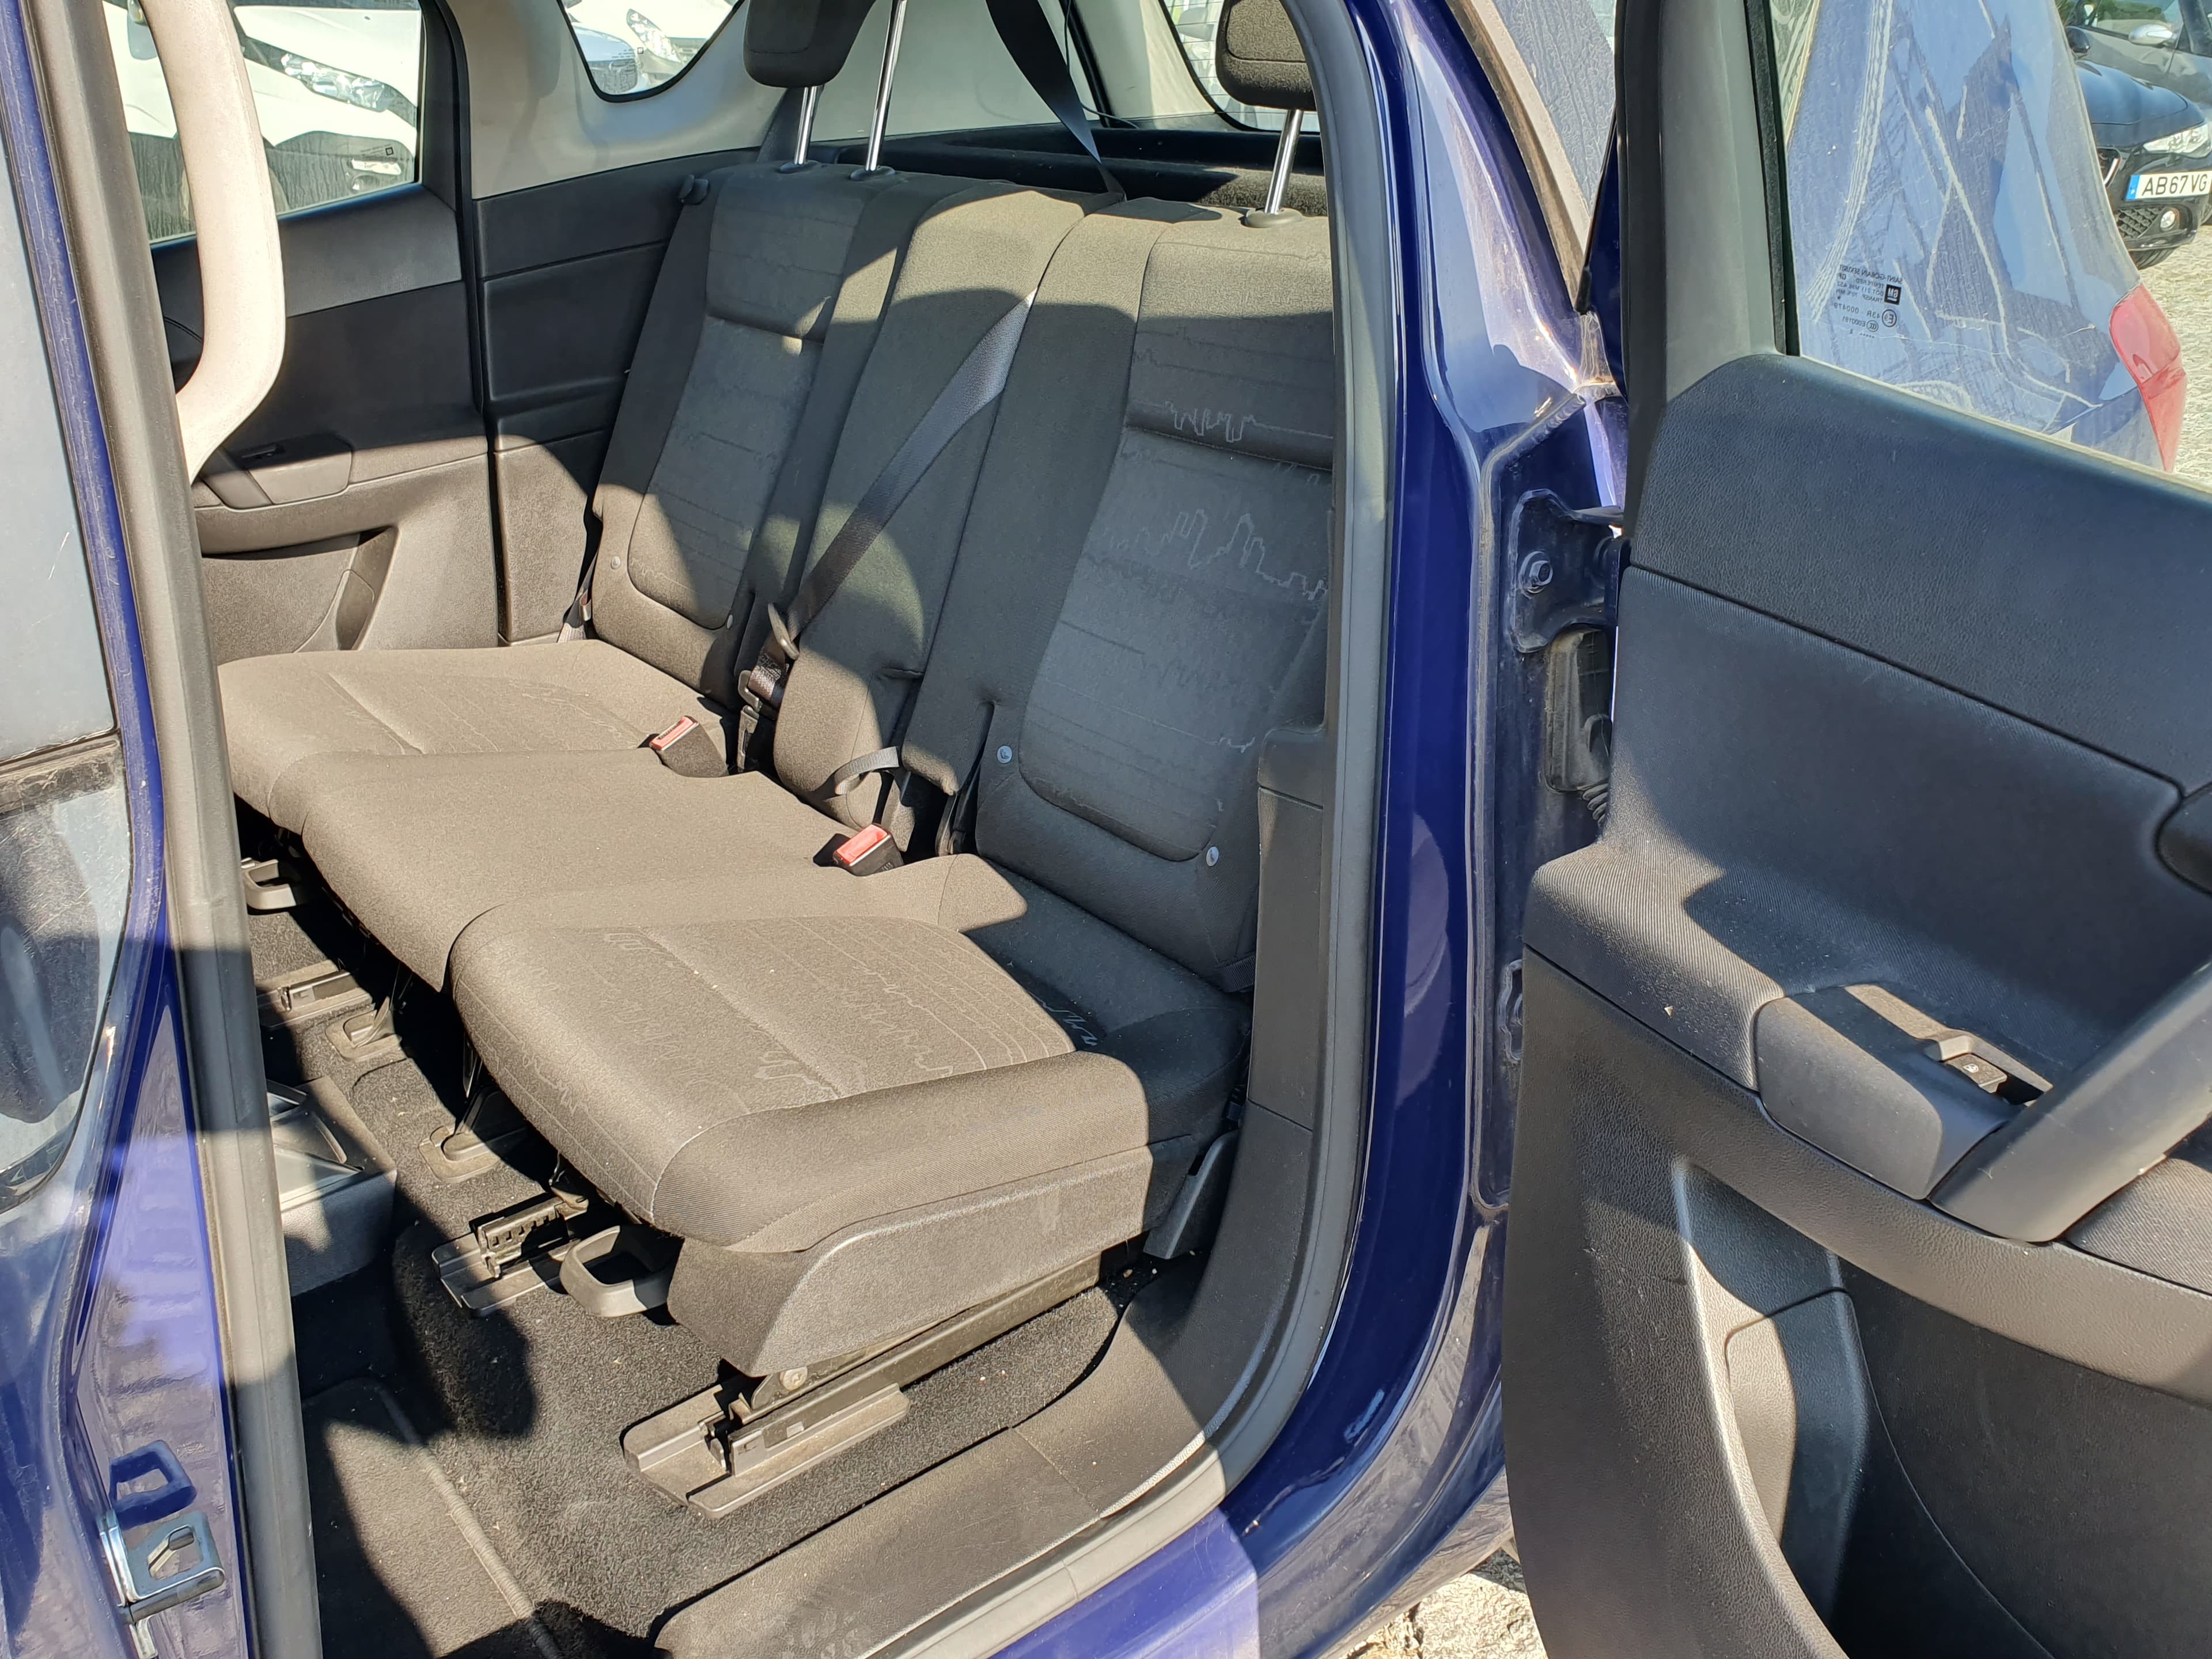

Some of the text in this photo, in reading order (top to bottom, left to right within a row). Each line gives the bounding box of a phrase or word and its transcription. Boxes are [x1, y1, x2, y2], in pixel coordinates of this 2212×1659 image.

[2142, 174, 2207, 196] AB 67 VG
